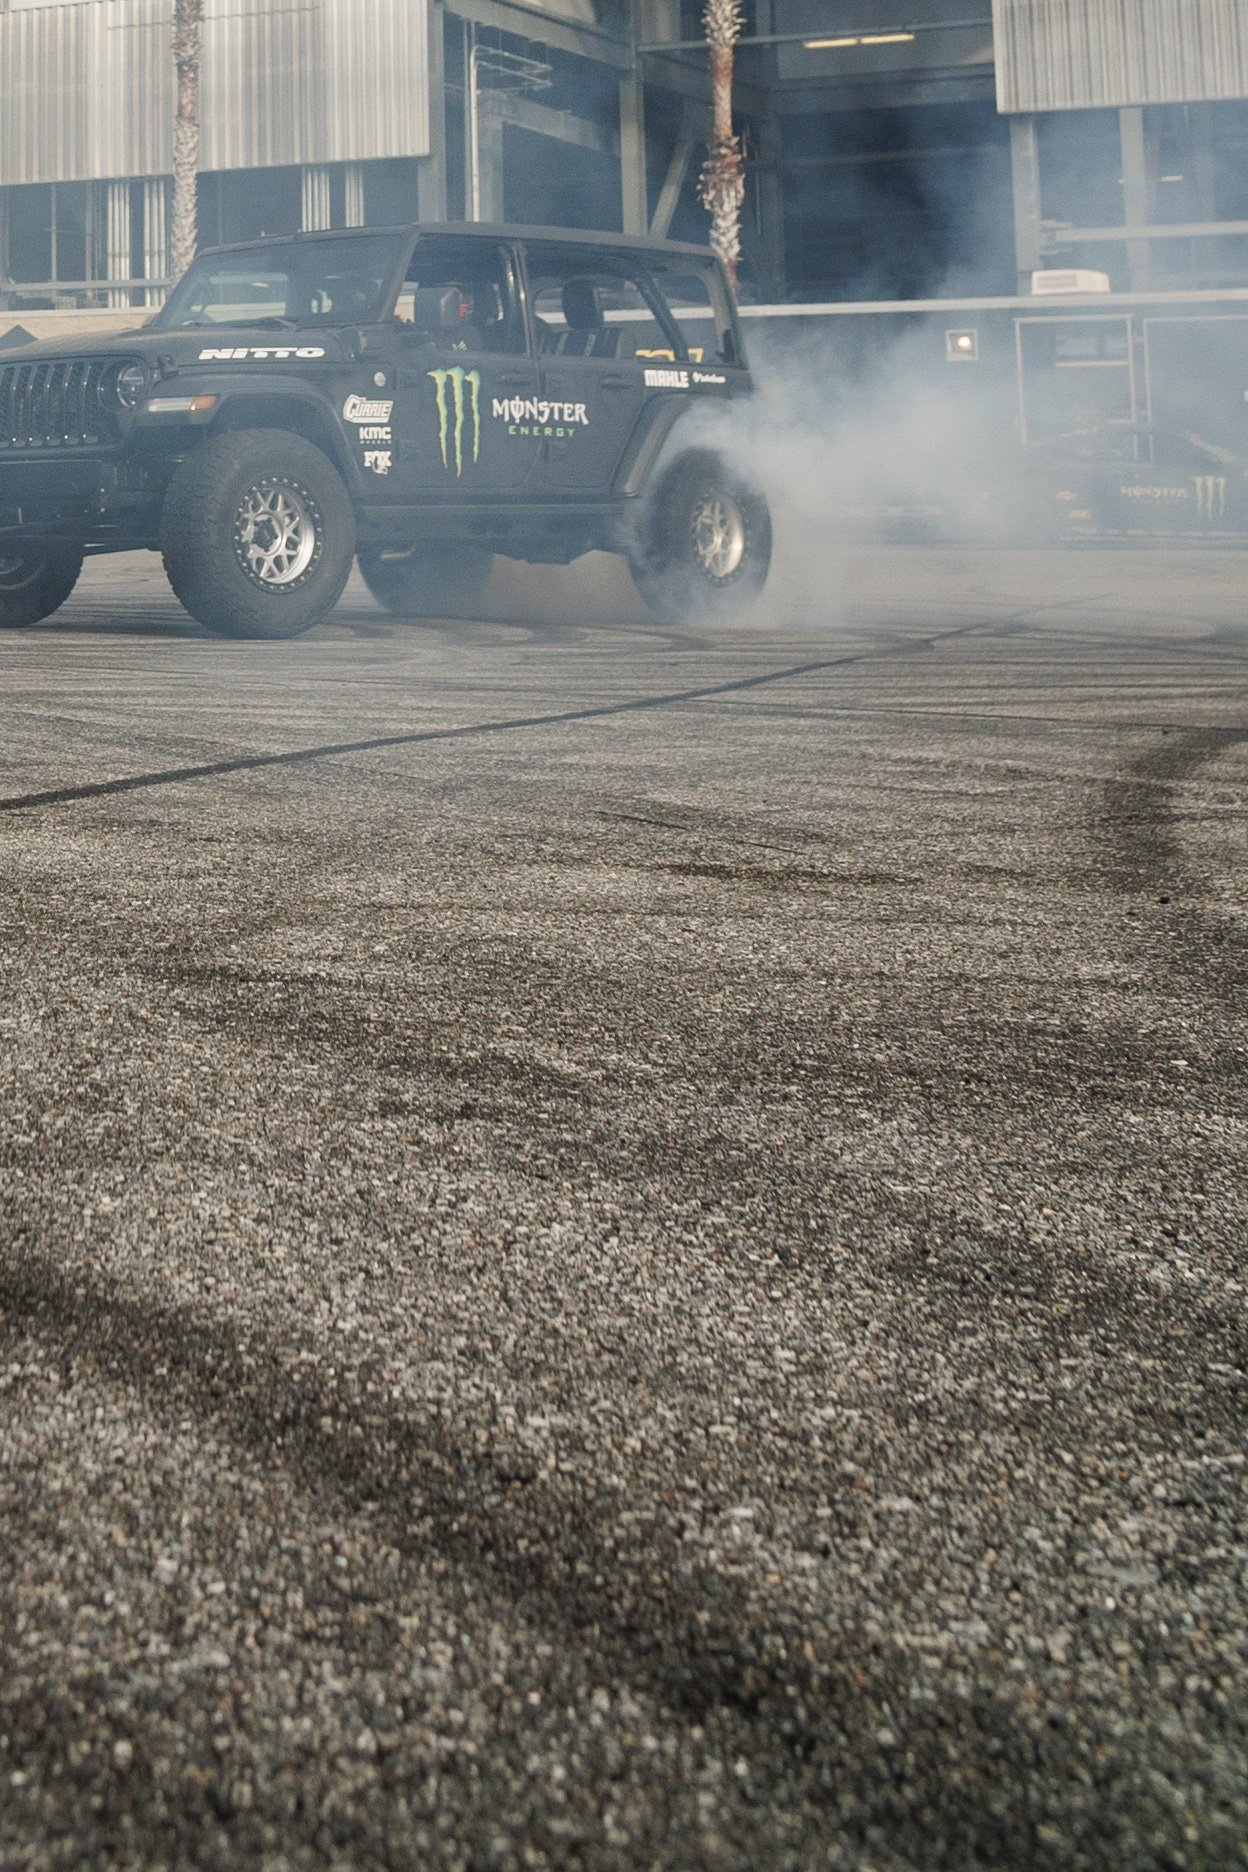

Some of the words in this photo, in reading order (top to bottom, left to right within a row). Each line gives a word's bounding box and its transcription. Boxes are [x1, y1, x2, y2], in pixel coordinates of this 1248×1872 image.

[198, 347, 326, 360] NITTO
[643, 369, 690, 388] MAHLE
[345, 396, 392, 420] CURRIE
[492, 395, 589, 425] MONSTER
[359, 426, 392, 440] KMC
[508, 425, 576, 438] ENERGY
